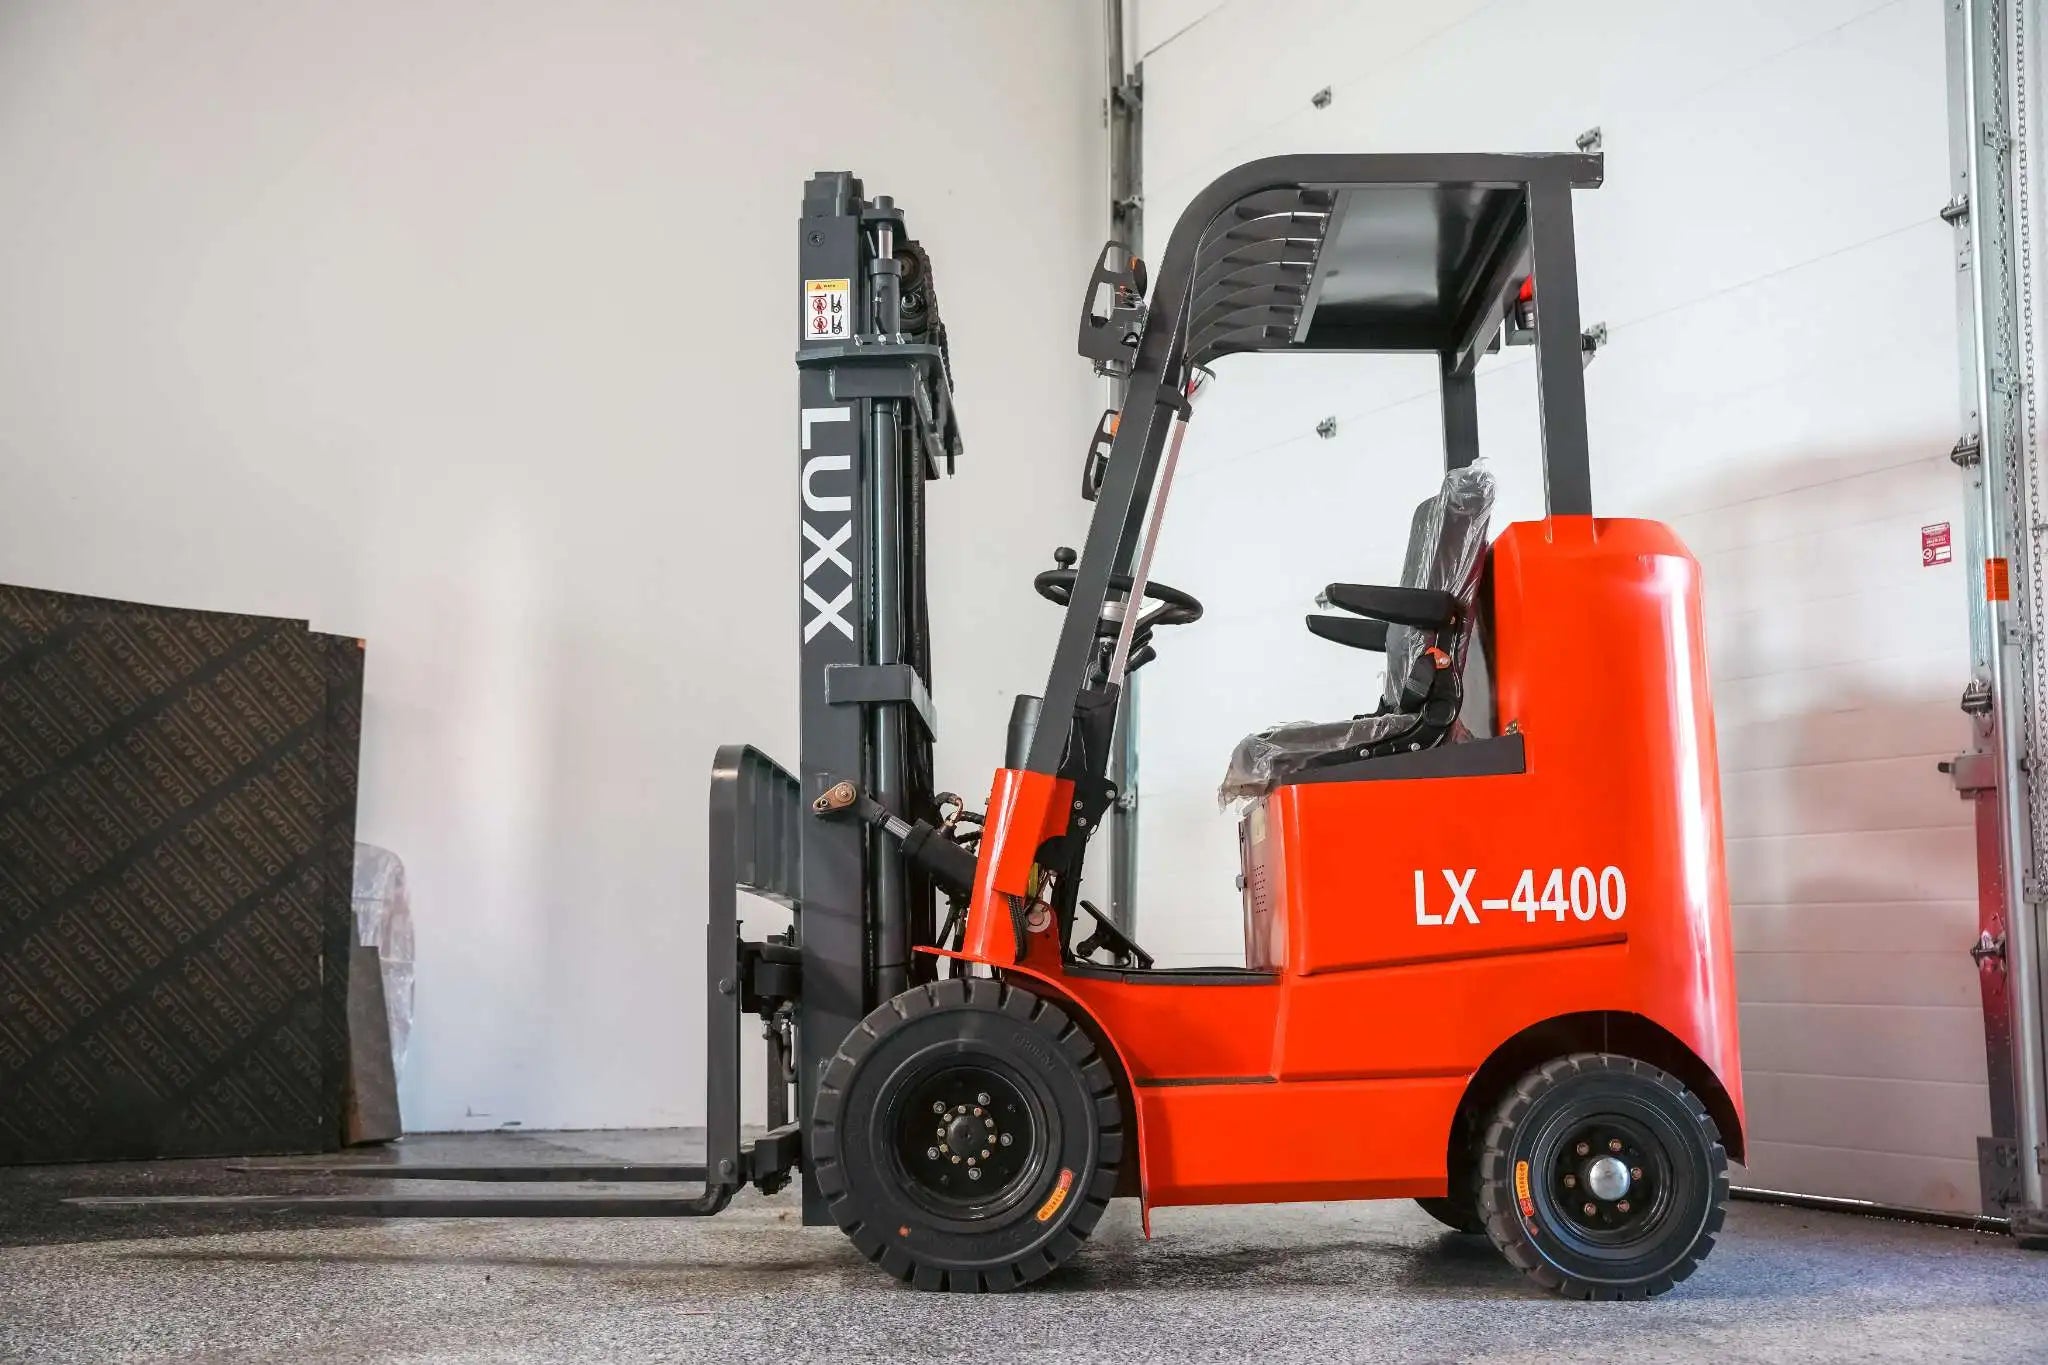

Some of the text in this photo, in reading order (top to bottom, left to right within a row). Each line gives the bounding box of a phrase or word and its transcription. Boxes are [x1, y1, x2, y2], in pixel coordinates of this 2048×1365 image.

[802, 406, 854, 645] LUXX
[182, 687, 252, 766] DURAPLEX
[213, 672, 281, 746] DURAPLEX
[123, 732, 196, 808] DURAPLEX
[152, 710, 224, 787] DURAPLEX
[91, 753, 164, 829] DURAPLEX
[240, 779, 310, 855] DURAPLEX
[180, 823, 253, 898] DURAPLEX
[213, 801, 281, 877] DURAPLEX
[84, 889, 162, 969] DURAPLEX
[121, 864, 193, 945] DURAPLEX
[1414, 865, 1627, 926] LX-4400
[22, 936, 97, 1018] DURAPLEX
[52, 911, 130, 992] DURAPLEX
